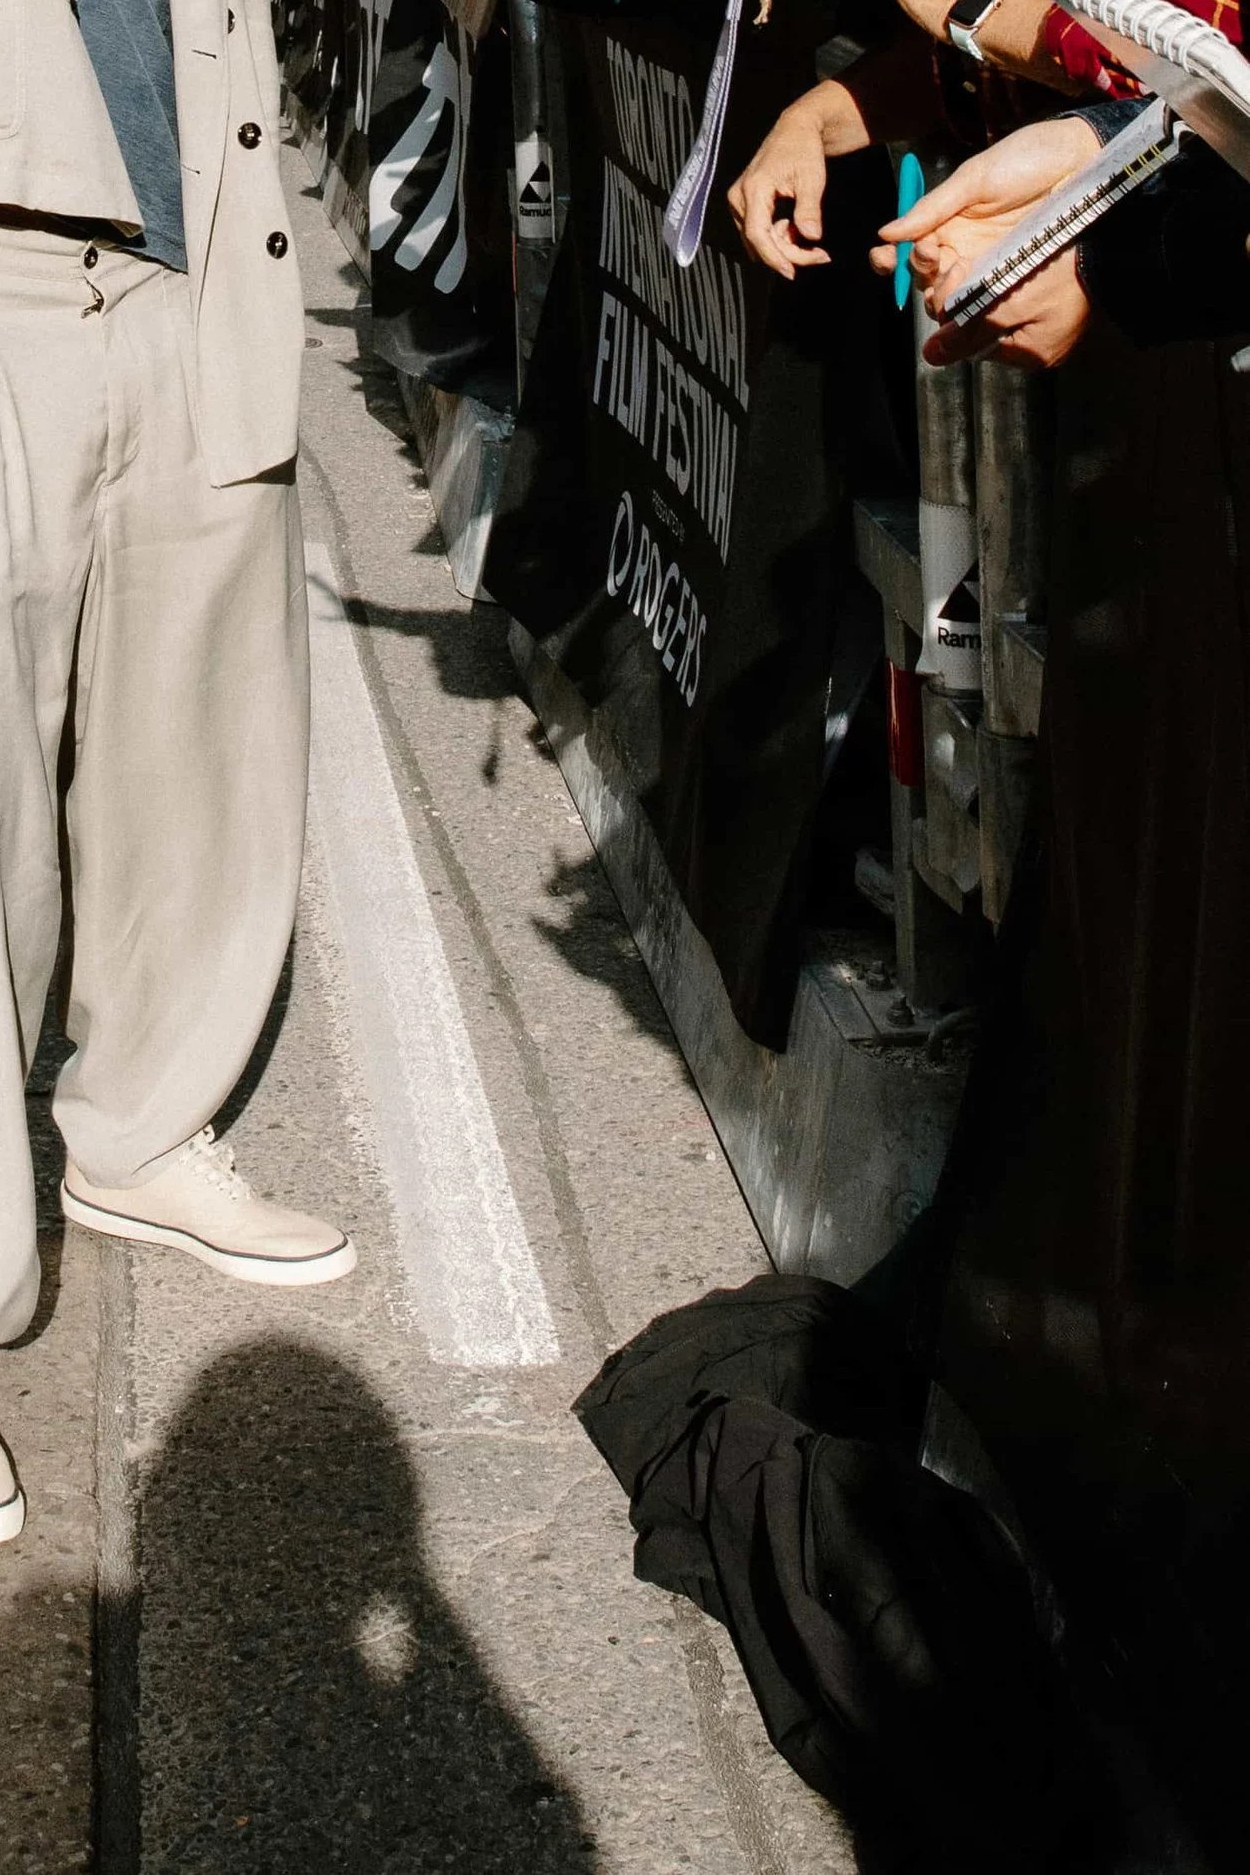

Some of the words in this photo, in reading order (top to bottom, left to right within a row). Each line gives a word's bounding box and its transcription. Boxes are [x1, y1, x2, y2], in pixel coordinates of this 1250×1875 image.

[606, 36, 695, 195] TORONTO
[593, 291, 648, 445] FILM
[654, 337, 738, 565] FESTIVAL
[627, 522, 707, 708] ROGERS
